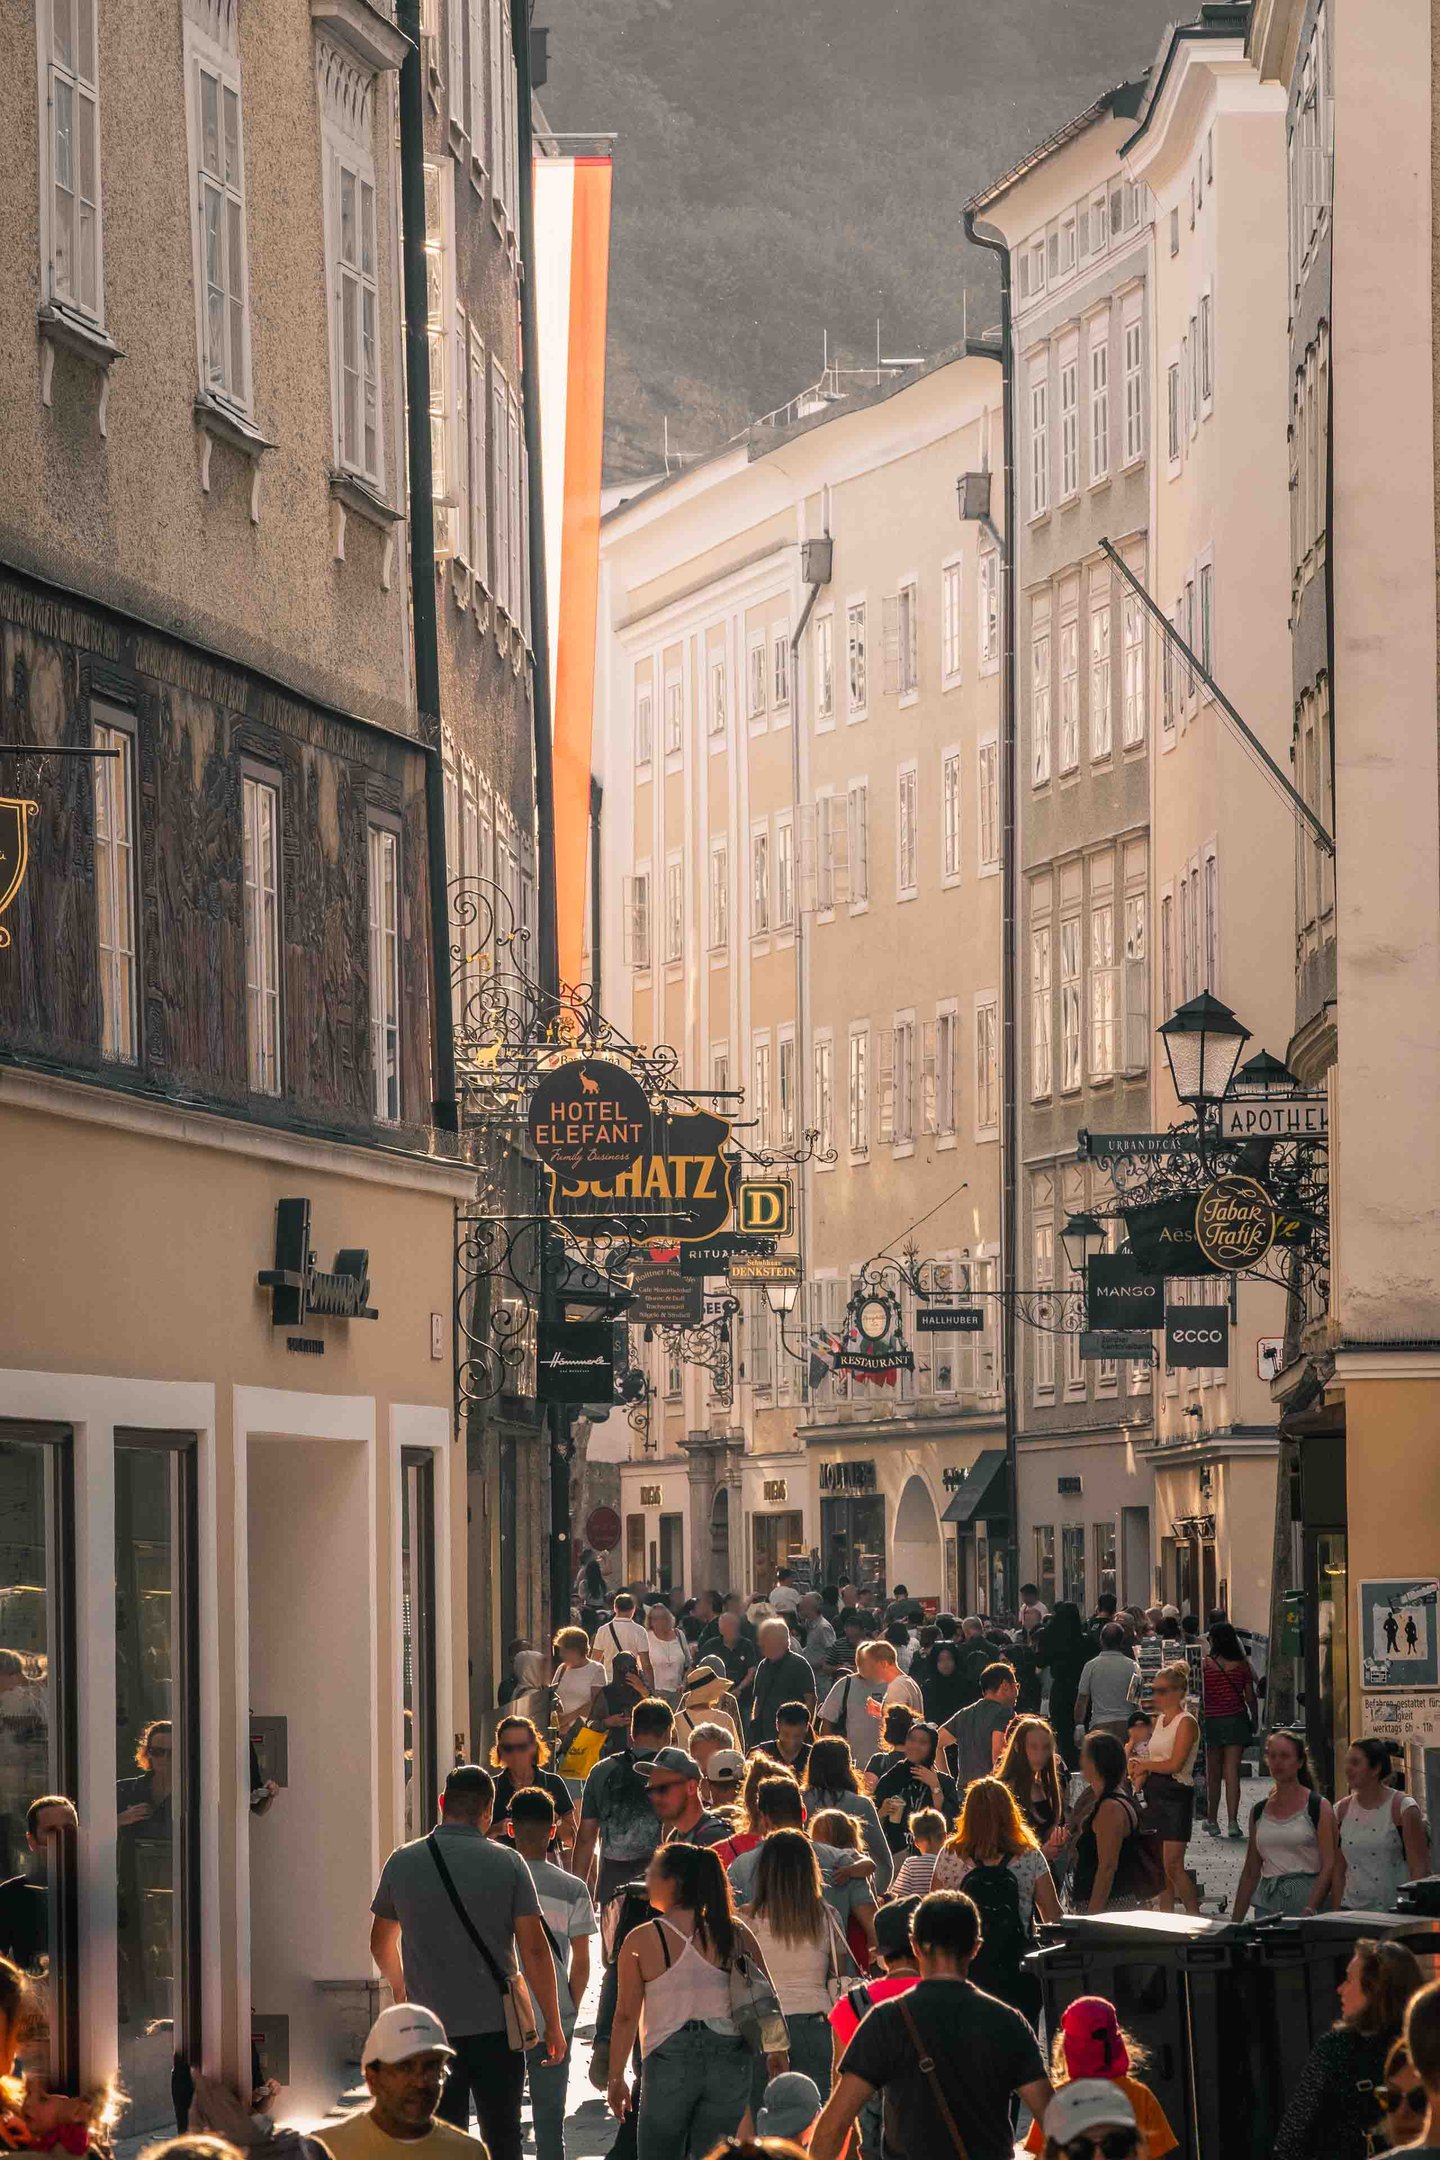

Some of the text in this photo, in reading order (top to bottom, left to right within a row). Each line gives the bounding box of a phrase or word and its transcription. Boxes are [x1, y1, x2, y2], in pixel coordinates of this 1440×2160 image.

[550, 1102, 628, 1121] HOTEL
[536, 1124, 643, 1144] ELEFANT
[1108, 1140, 1145, 1152] URBAN
[550, 1147, 630, 1169] Family Business
[747, 1191, 780, 1225] D
[1203, 1198, 1266, 1222] Tabak
[1205, 1222, 1266, 1247] Trafik
[732, 1267, 797, 1276] DENKSTEIN
[1096, 1286, 1155, 1297] MANGO
[922, 1316, 978, 1324] HALLHUBER
[1173, 1330, 1222, 1343] ecco
[840, 1355, 910, 1369] RESTAURANT
